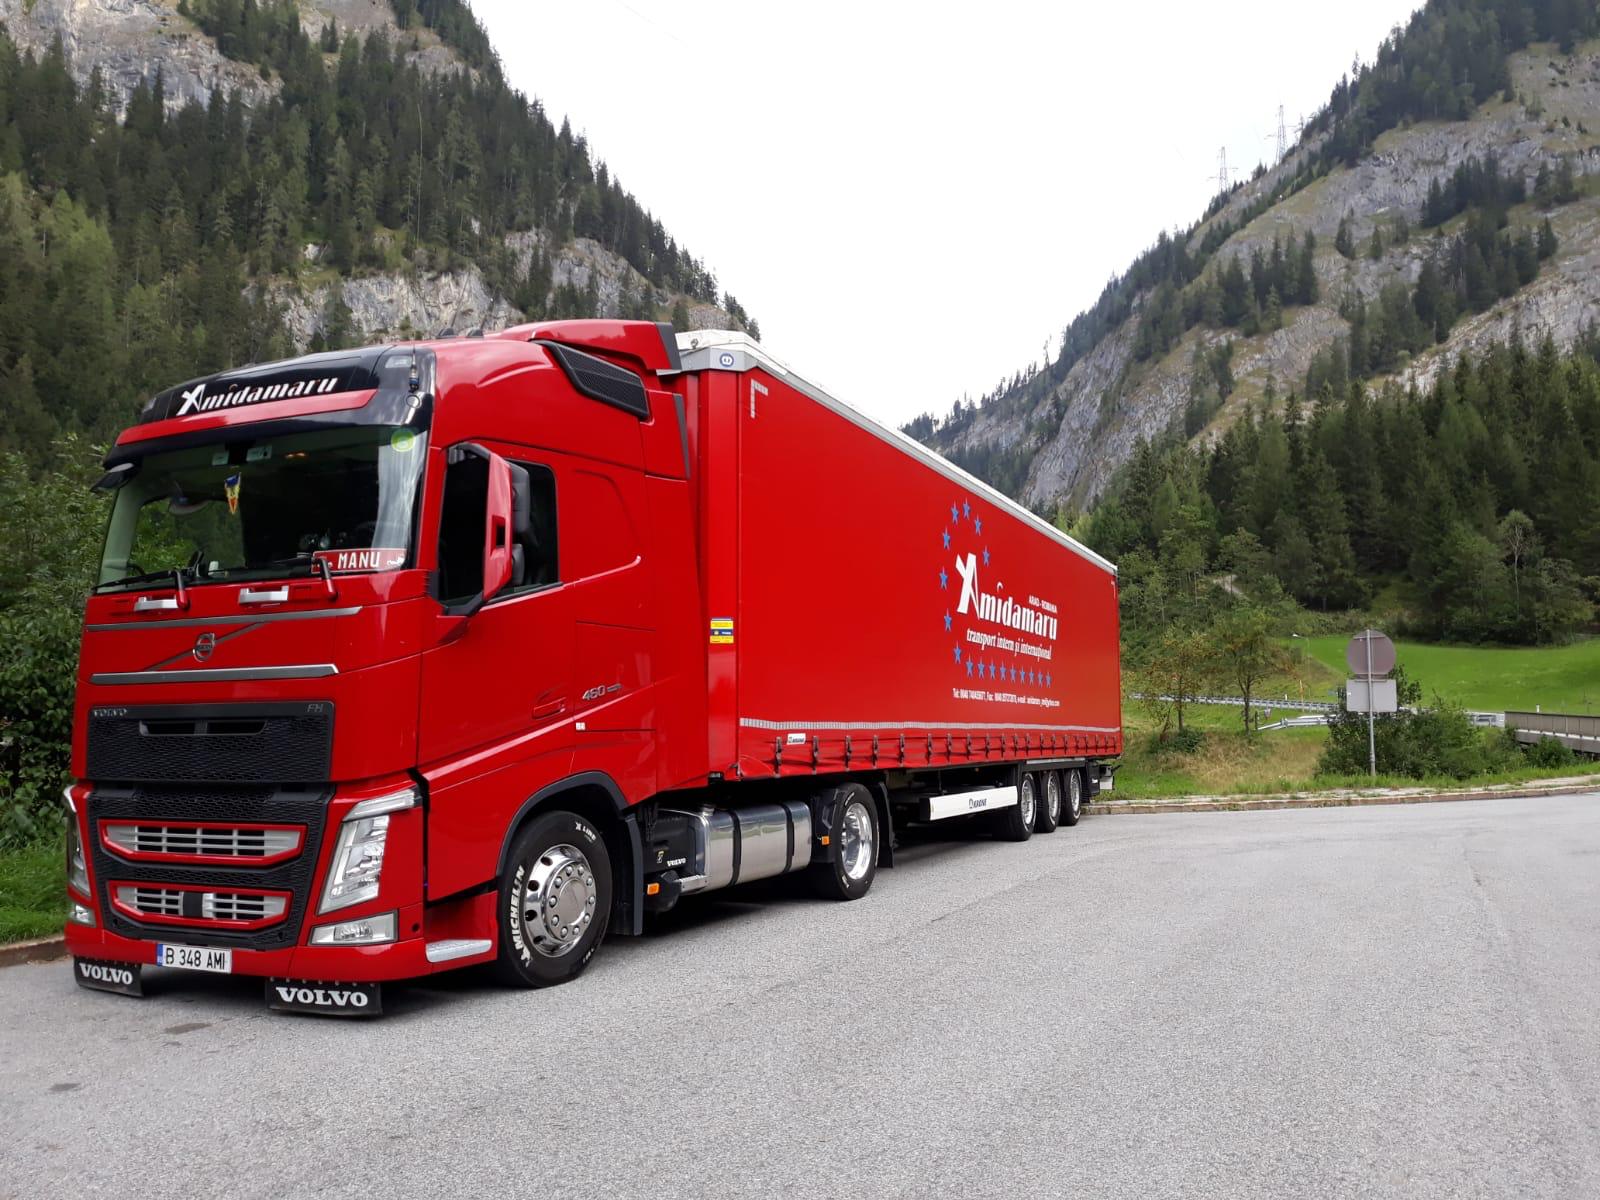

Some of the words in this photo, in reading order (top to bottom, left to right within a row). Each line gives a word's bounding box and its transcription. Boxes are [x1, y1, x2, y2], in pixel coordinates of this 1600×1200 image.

[337, 551, 381, 569] MANU
[966, 628, 997, 651] transport
[582, 685, 606, 700] 460
[93, 708, 128, 718] VOLVO
[306, 703, 324, 713] FH
[666, 857, 687, 867] VOLVO
[510, 865, 526, 951] MICHELIN
[165, 947, 175, 965] B
[179, 949, 202, 967] 348
[206, 951, 225, 970] AMI
[79, 962, 134, 985] VOLVO
[275, 985, 369, 1007] VOLVO
